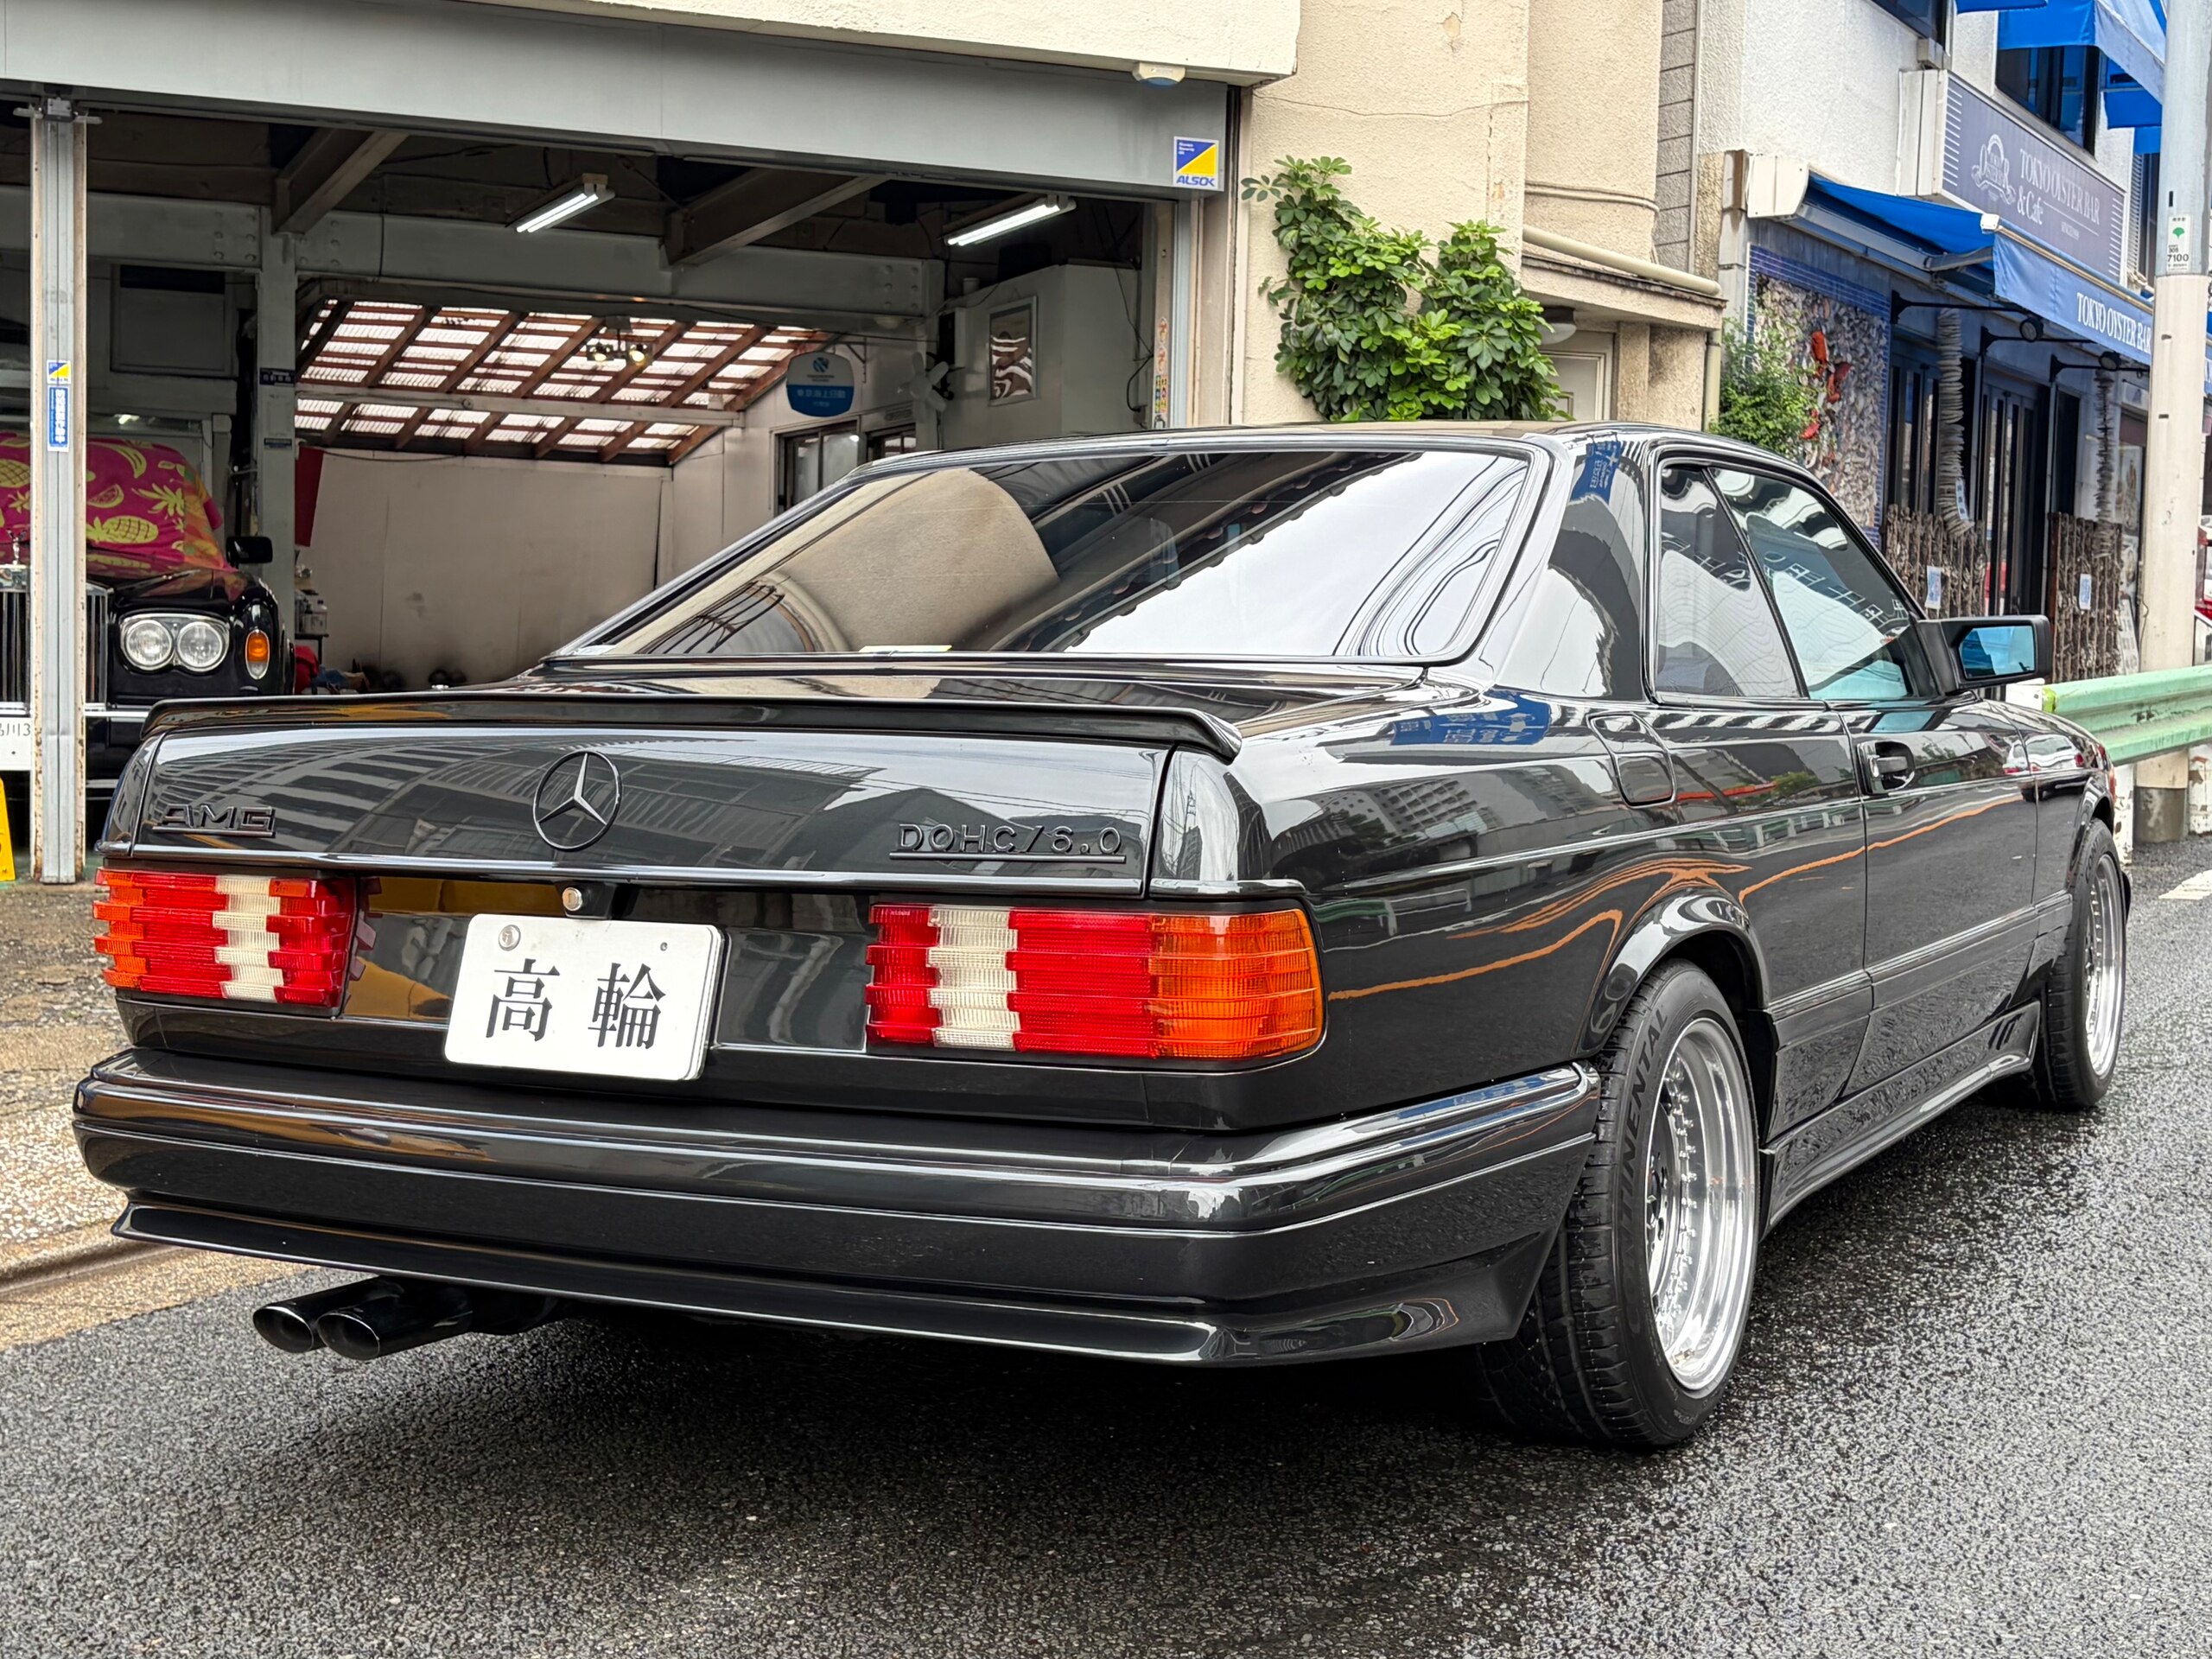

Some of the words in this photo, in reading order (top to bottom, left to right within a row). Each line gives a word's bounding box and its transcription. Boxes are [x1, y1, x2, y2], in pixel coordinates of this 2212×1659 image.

[1176, 175, 1215, 187] ALSOK
[2020, 148, 2050, 194] TOKYO
[2051, 171, 2083, 215] OYSTER
[2083, 191, 2100, 225] BAR
[2167, 253, 2190, 263] 7100
[2076, 292, 2107, 334] TOKYO
[2107, 308, 2137, 347] OYSTER
[2137, 322, 2152, 355] BAR
[159, 802, 276, 832] AMG
[898, 823, 1122, 855] DOHC/6.0
[485, 957, 667, 1050] 高輪
